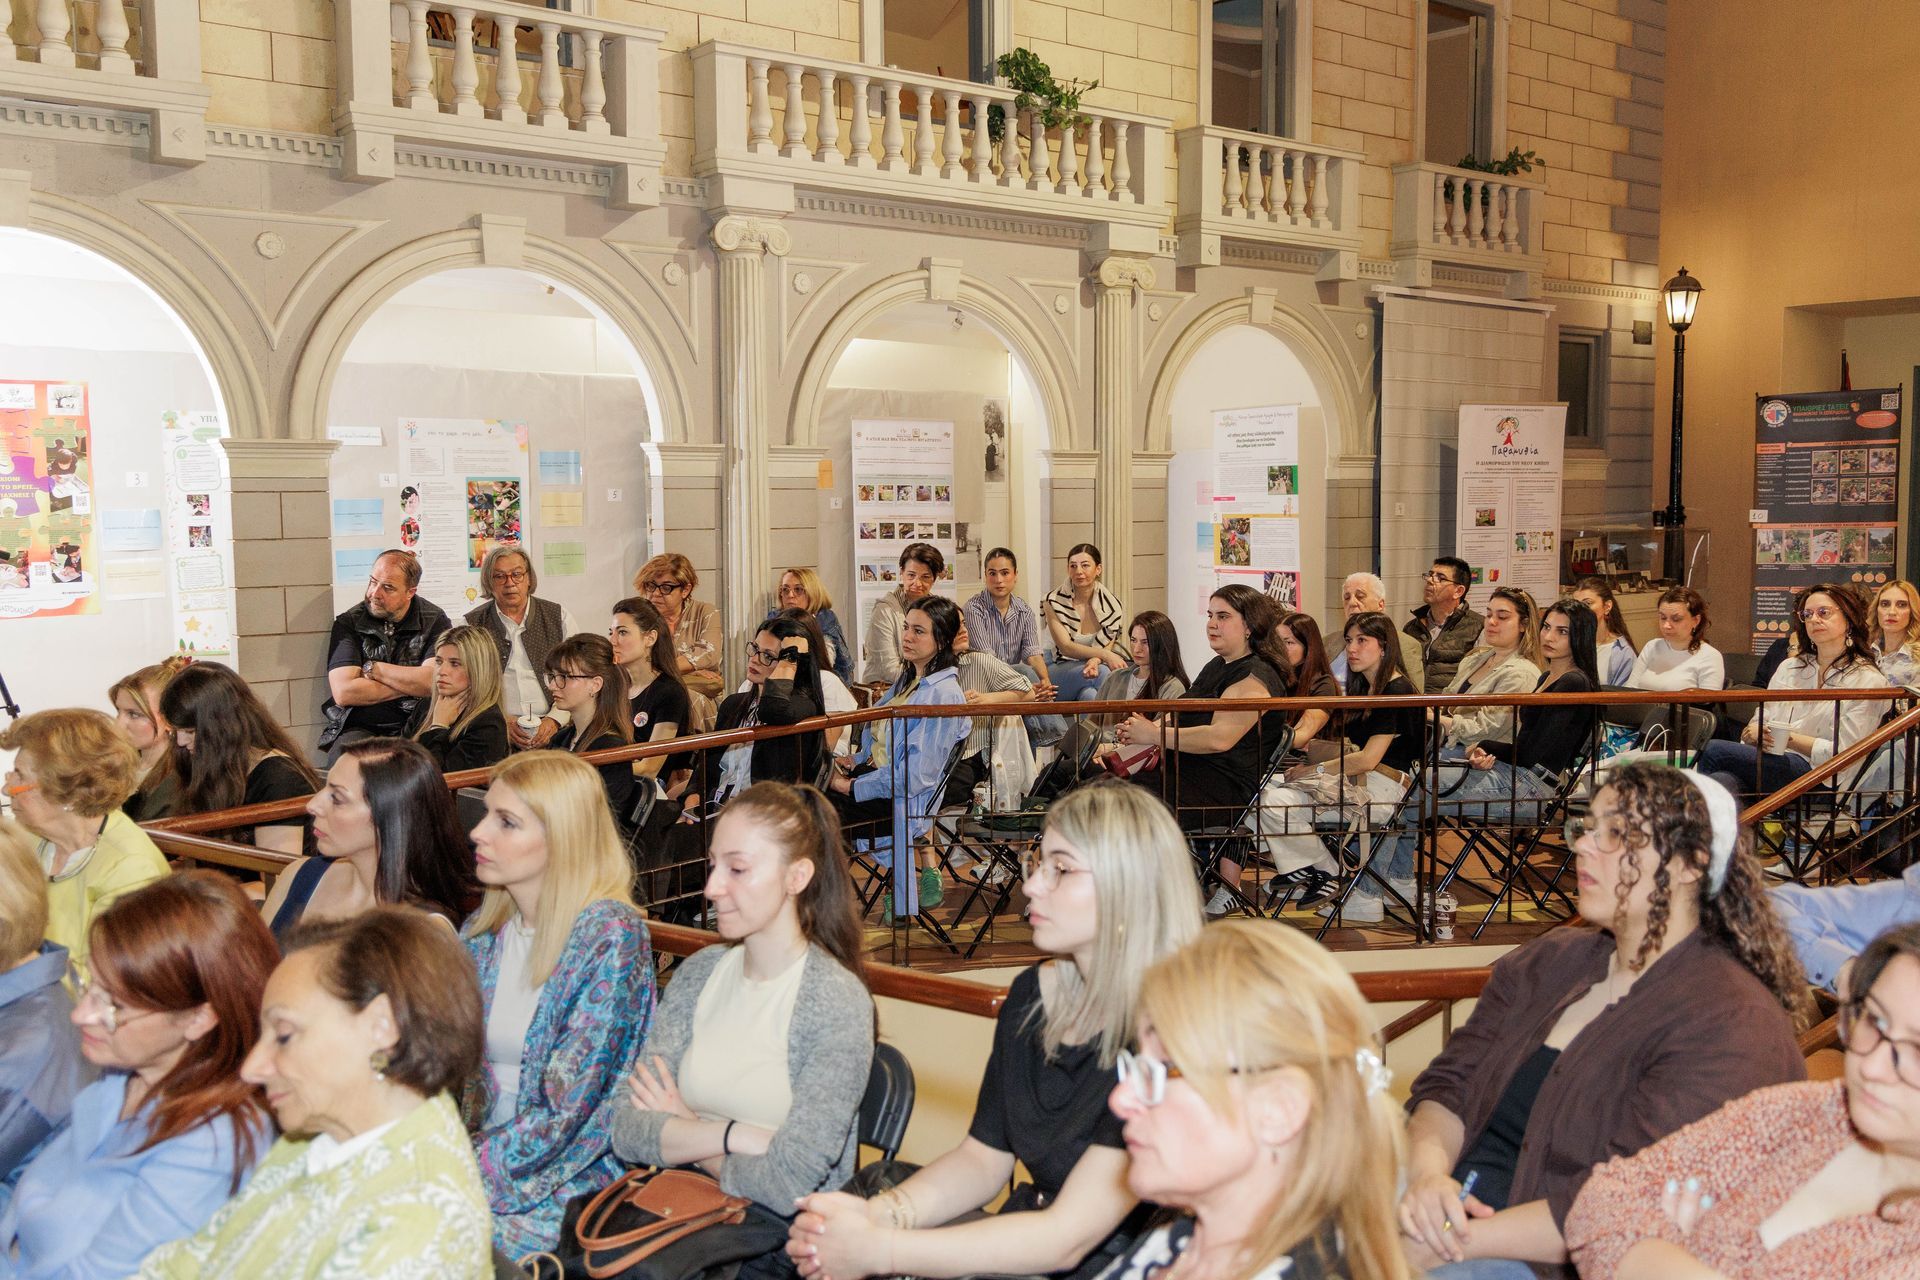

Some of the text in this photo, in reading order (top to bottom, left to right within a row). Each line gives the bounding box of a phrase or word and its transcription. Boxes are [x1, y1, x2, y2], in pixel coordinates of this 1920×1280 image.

[135, 474, 140, 486] 3
[384, 475, 390, 484] 4
[612, 490, 617, 499] 5
[1752, 512, 1764, 520] 10
